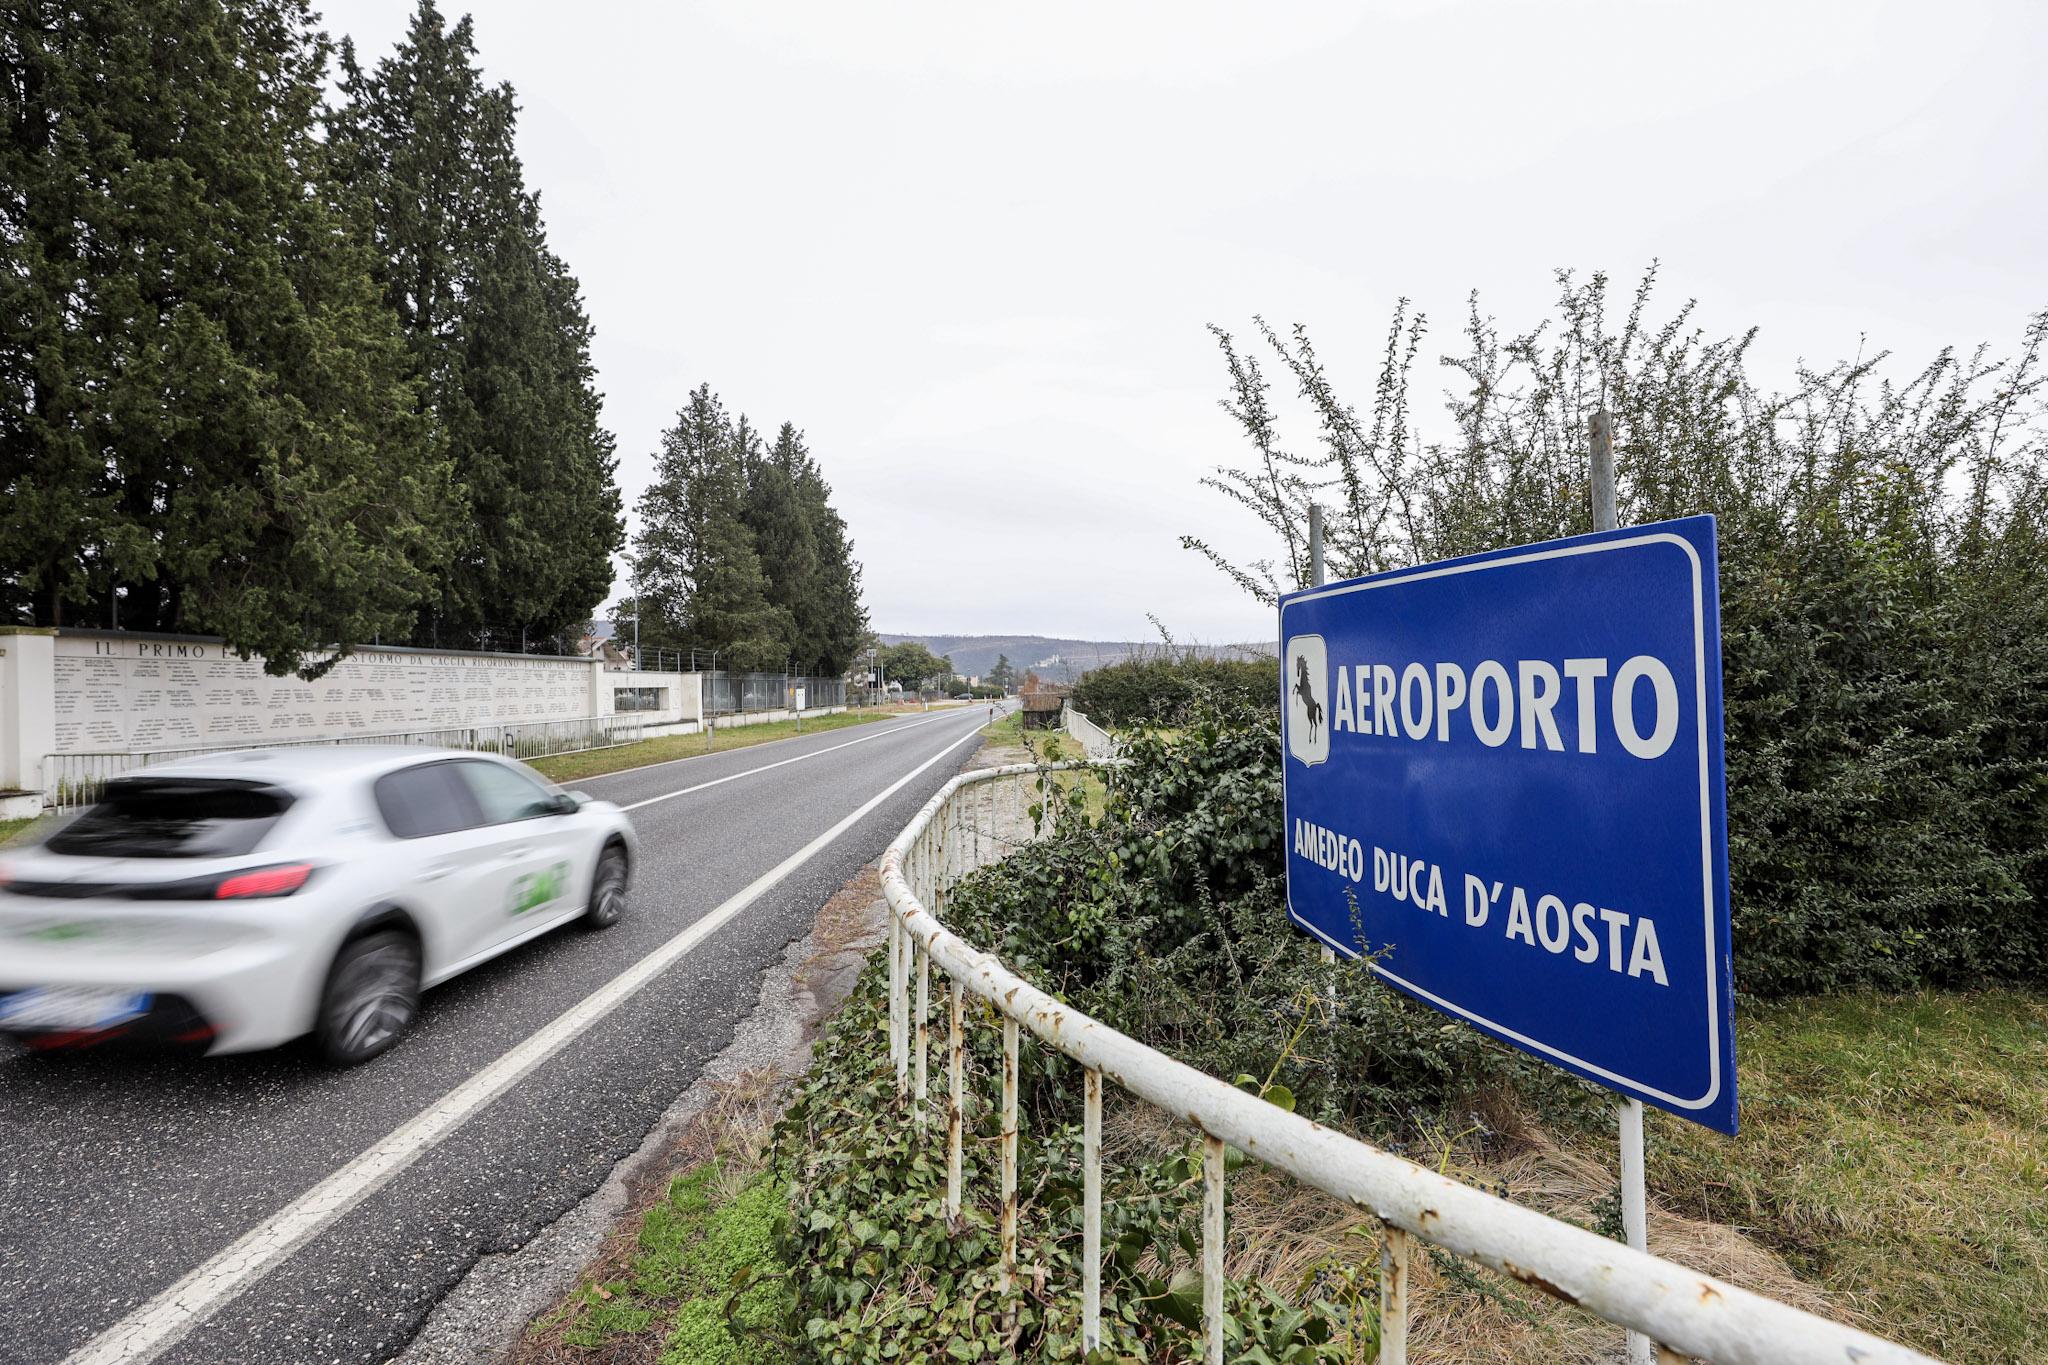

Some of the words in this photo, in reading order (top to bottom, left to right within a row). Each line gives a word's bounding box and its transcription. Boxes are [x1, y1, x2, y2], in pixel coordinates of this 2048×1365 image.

[95, 641, 117, 656] IL
[139, 643, 205, 659] PRIMO
[351, 653, 402, 665] STORMO
[410, 655, 422, 665] DA
[431, 656, 465, 667] CACCIA
[473, 658, 519, 668] RICORDANO
[532, 660, 552, 670] LORO
[1334, 655, 1680, 760] AEROPORTO
[1294, 818, 1364, 883] AMEDEO
[1374, 846, 1448, 918] DUCA
[1465, 873, 1669, 987] D'AOSTA
